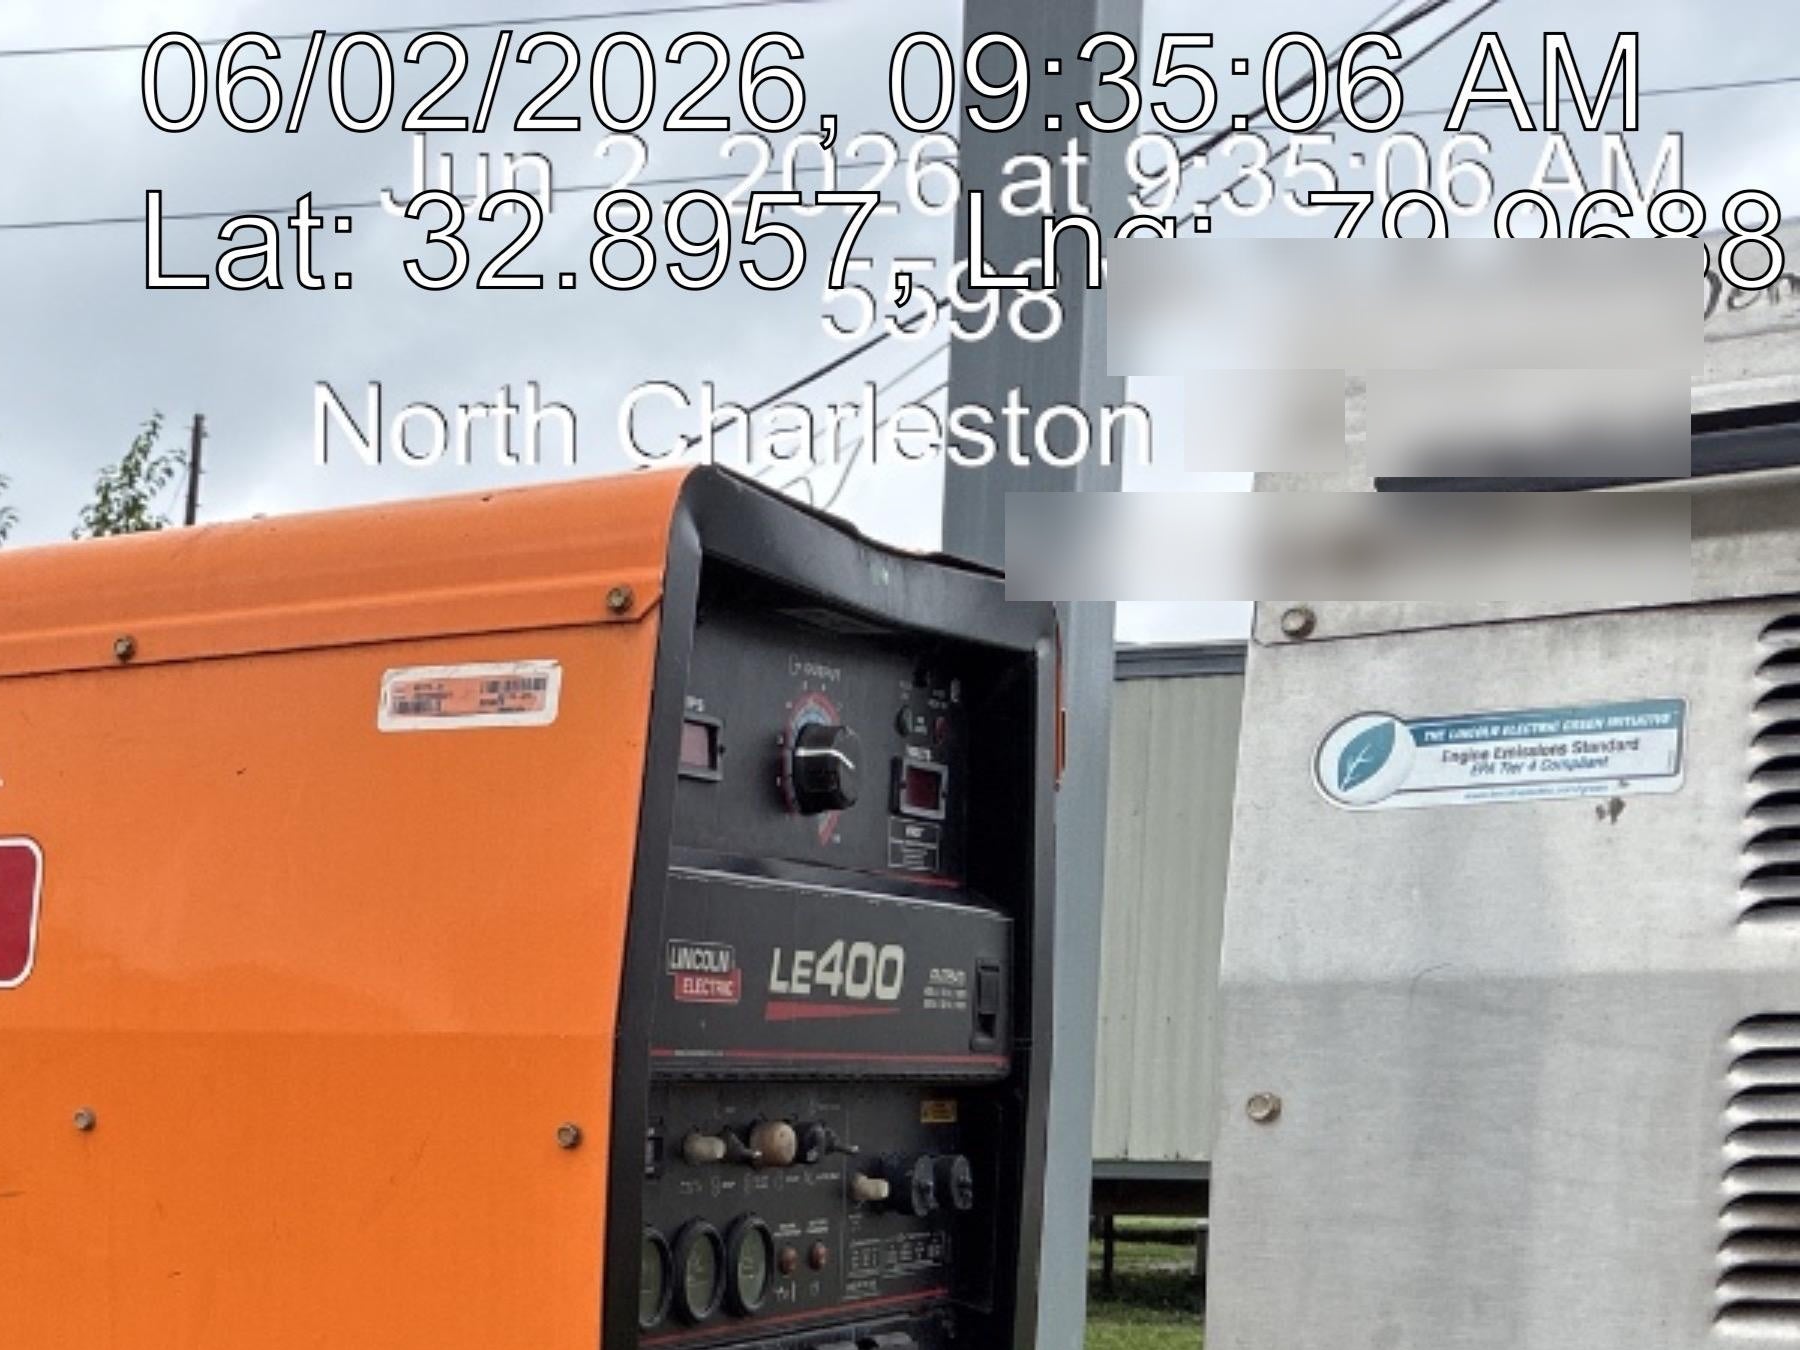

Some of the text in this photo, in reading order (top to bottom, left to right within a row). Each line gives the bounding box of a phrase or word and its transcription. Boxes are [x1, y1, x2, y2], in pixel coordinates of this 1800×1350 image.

[1442, 737, 1641, 766] Engine Emissions Standard
[1500, 761, 1525, 775] Tier
[1541, 756, 1610, 774] Compliant
[670, 946, 731, 973] LINCOLN
[768, 938, 905, 1001] LE400
[682, 977, 735, 997] ELECTRIC
